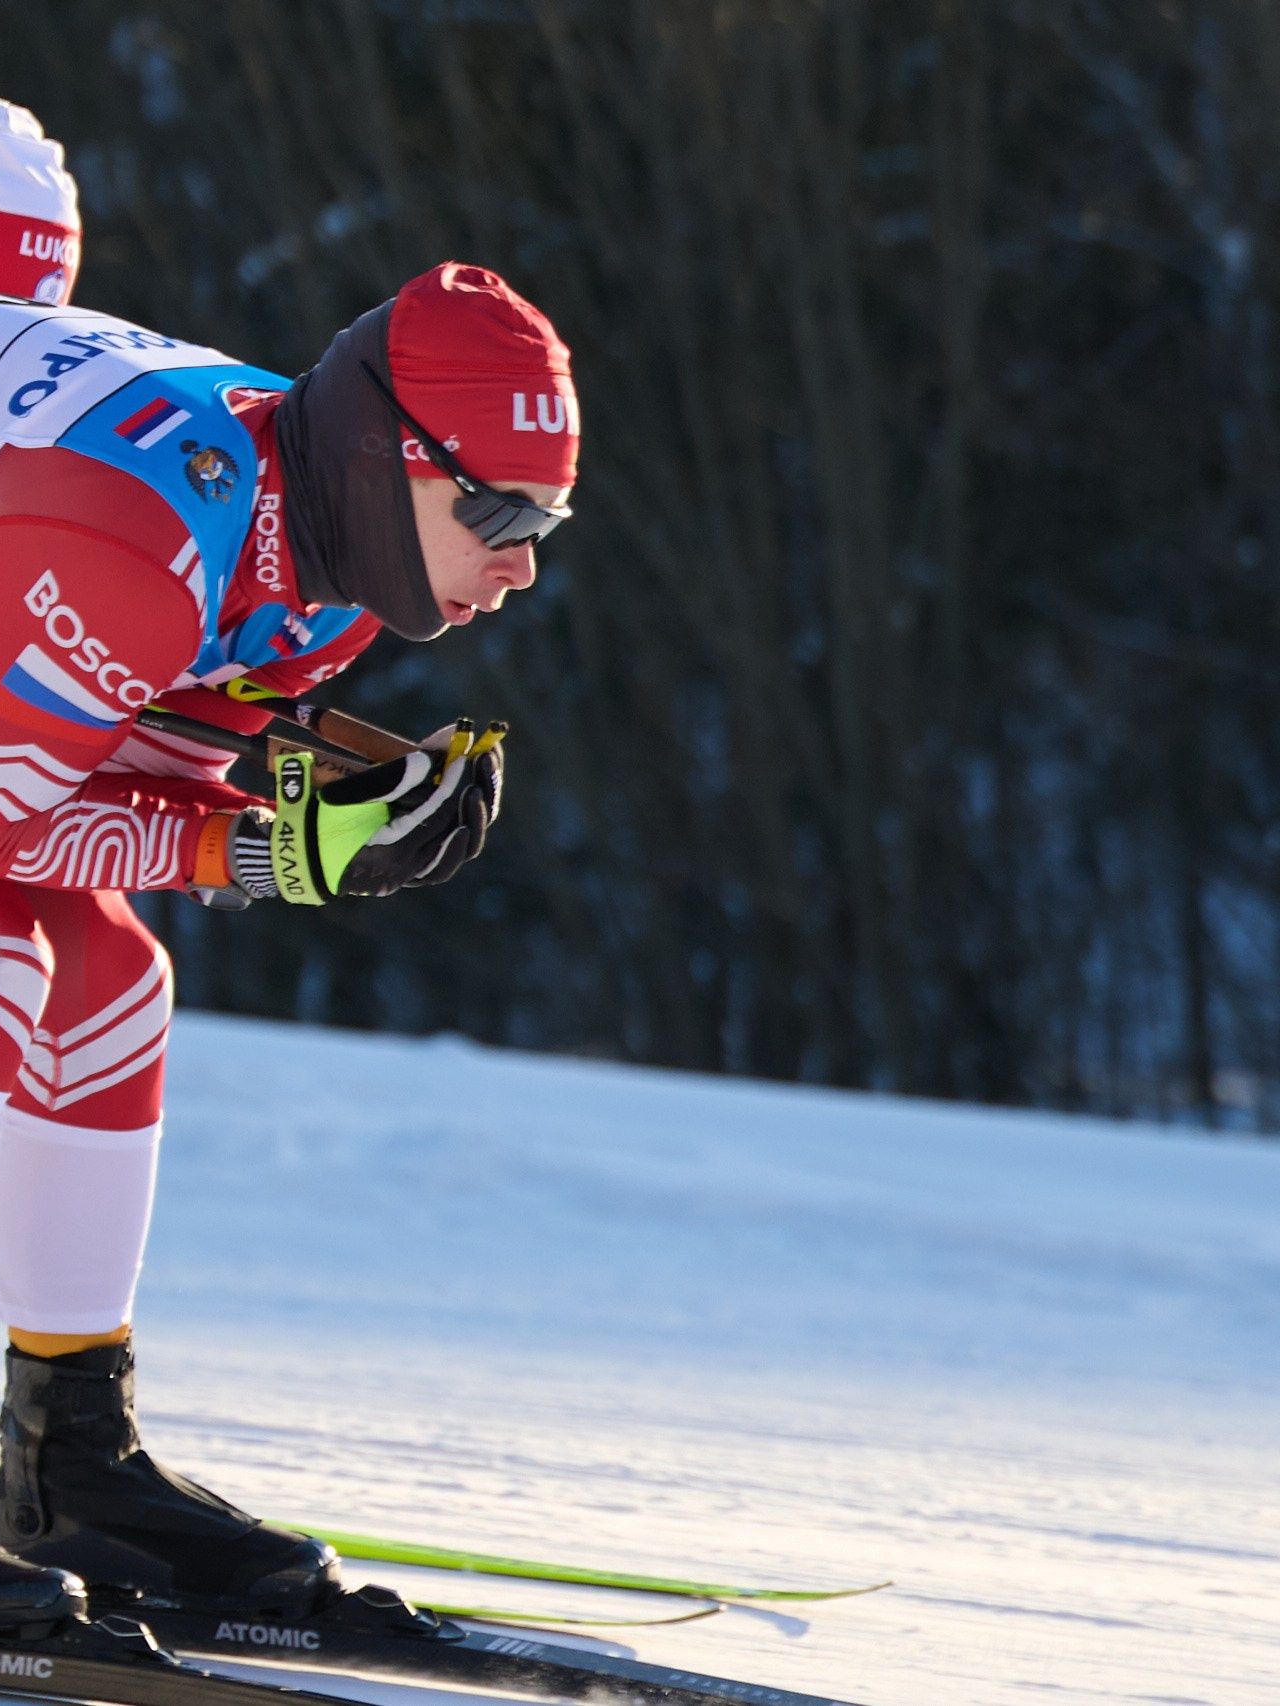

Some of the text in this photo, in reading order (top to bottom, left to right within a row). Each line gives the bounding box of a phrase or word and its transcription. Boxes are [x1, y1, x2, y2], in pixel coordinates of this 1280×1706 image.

[7, 330, 190, 418] ОСАГРО
[255, 493, 280, 585] BOSCO
[23, 568, 155, 709] BOSCO
[214, 1621, 321, 1650] ATOMIC
